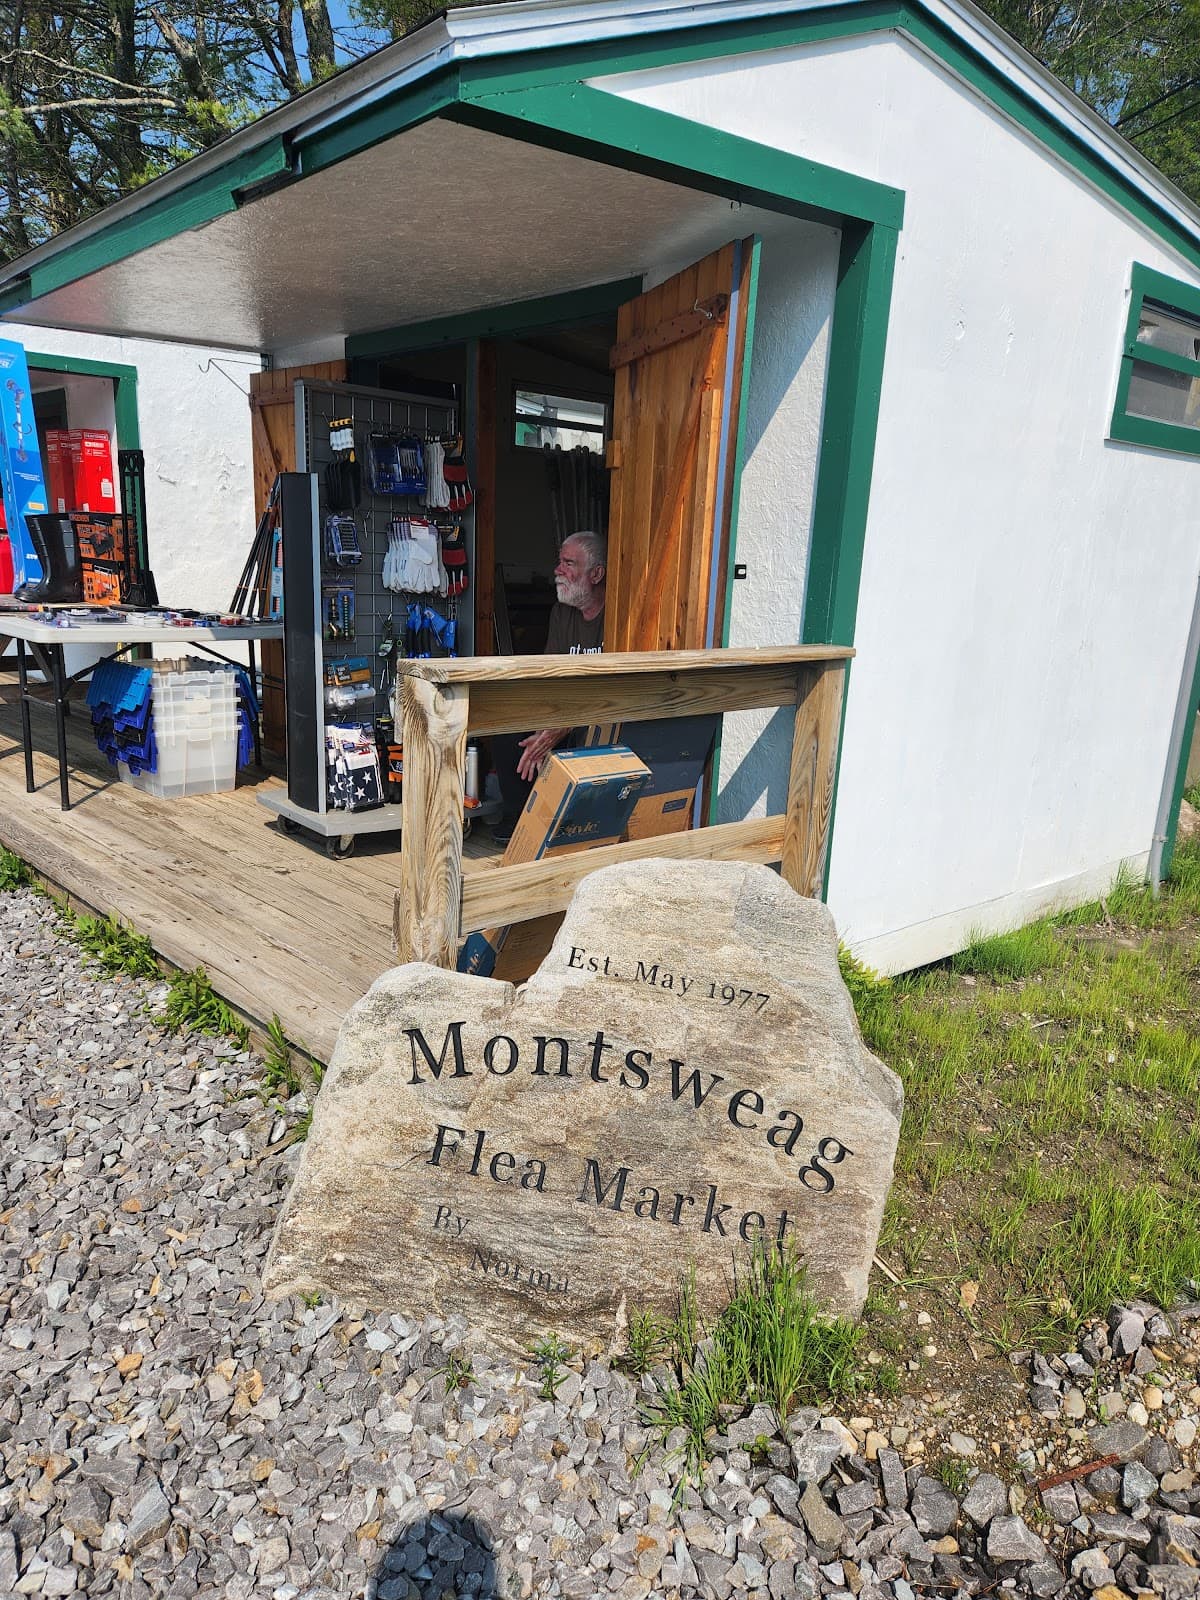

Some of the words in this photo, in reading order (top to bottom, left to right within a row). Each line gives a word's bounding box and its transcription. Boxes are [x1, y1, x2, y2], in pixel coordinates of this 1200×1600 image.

[567, 946, 619, 977] Est.
[634, 961, 694, 997] May
[708, 982, 770, 1014] 1977
[401, 1020, 855, 1194] Montsweag
[425, 1123, 549, 1193] Flea
[576, 1157, 795, 1250] Market
[433, 1204, 471, 1239] By
[469, 1248, 569, 1294] Norma
